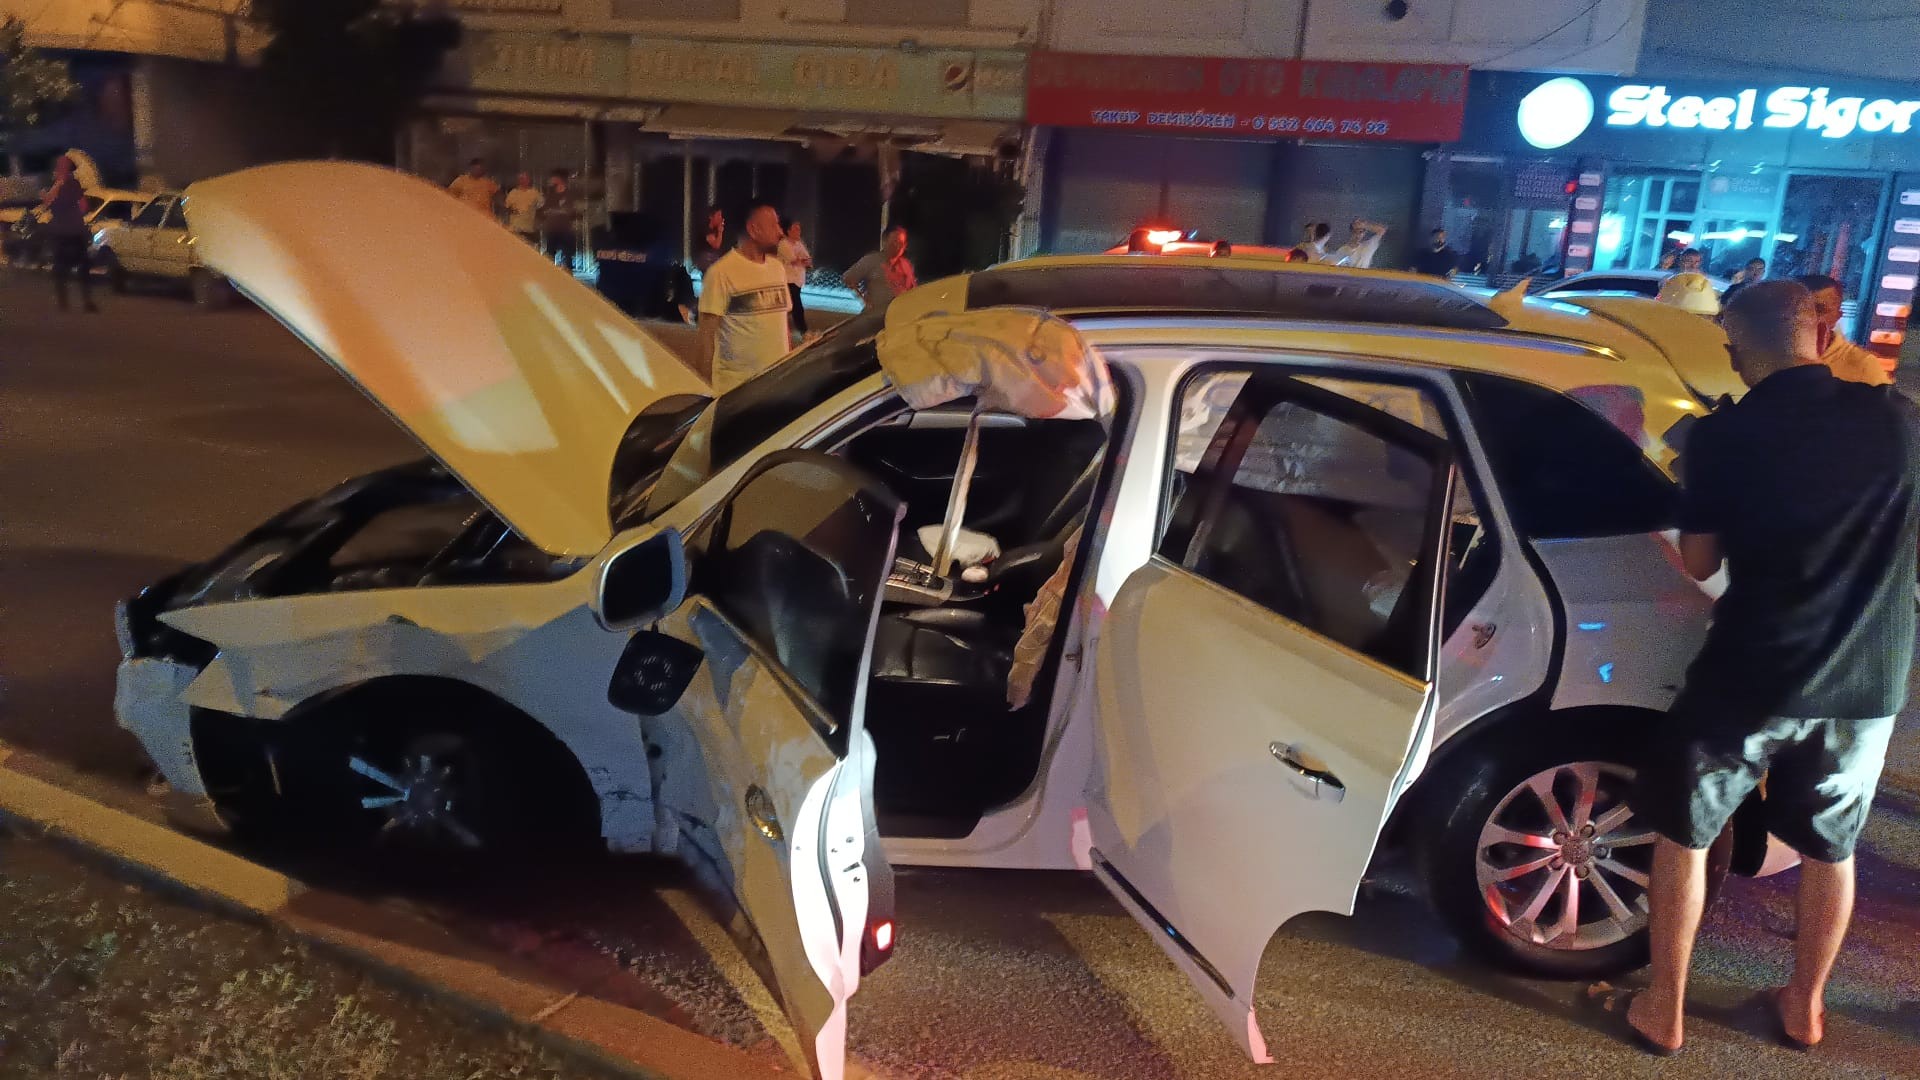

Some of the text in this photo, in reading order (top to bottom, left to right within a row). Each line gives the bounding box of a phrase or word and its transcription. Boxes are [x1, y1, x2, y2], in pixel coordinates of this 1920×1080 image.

[1090, 110, 1141, 124] YAKUP
[1252, 116, 1265, 130] 0
[1606, 84, 1920, 138] Steel Sigor
